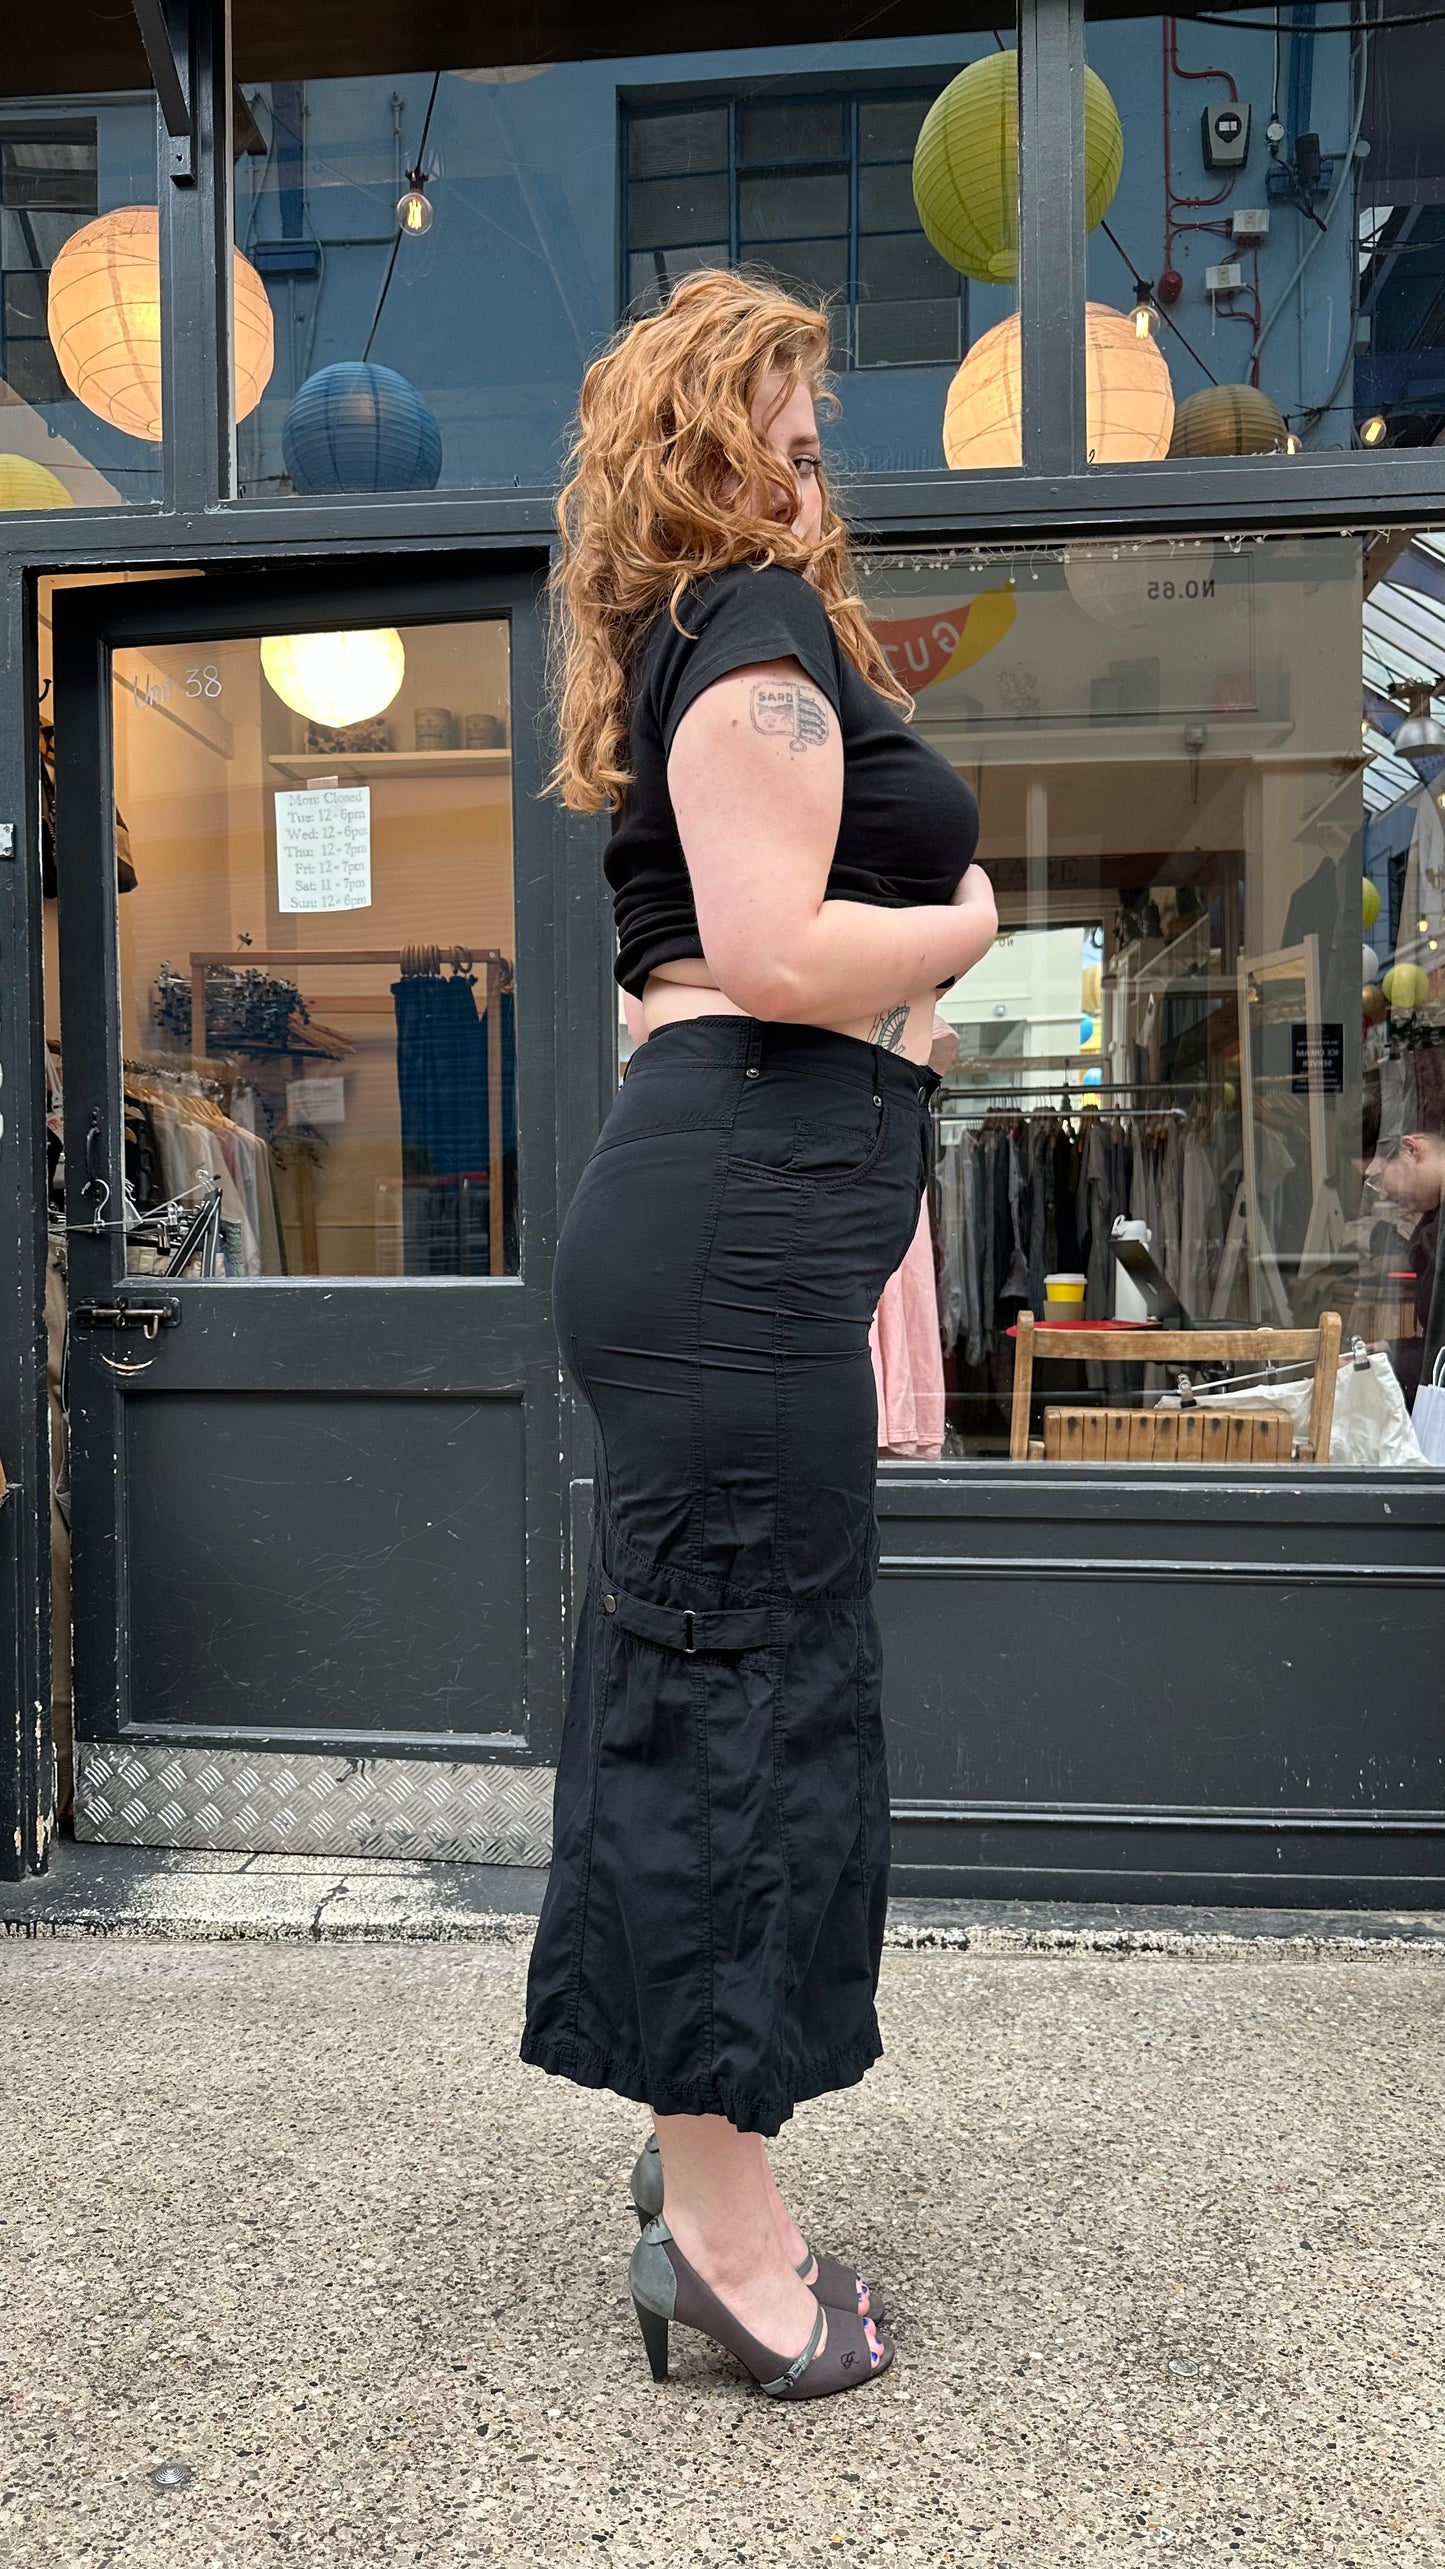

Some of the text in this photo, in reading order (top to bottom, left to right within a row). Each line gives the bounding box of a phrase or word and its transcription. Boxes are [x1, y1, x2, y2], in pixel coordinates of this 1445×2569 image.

[133, 665, 222, 710] Unit 38
[289, 791, 362, 806] Mon: Closed
[287, 811, 314, 823] Tue:
[285, 828, 319, 840] Wed:
[283, 846, 314, 858] Thu:
[294, 863, 315, 875] Fri:
[295, 879, 317, 892] Sat:
[290, 897, 317, 909] Sun:
